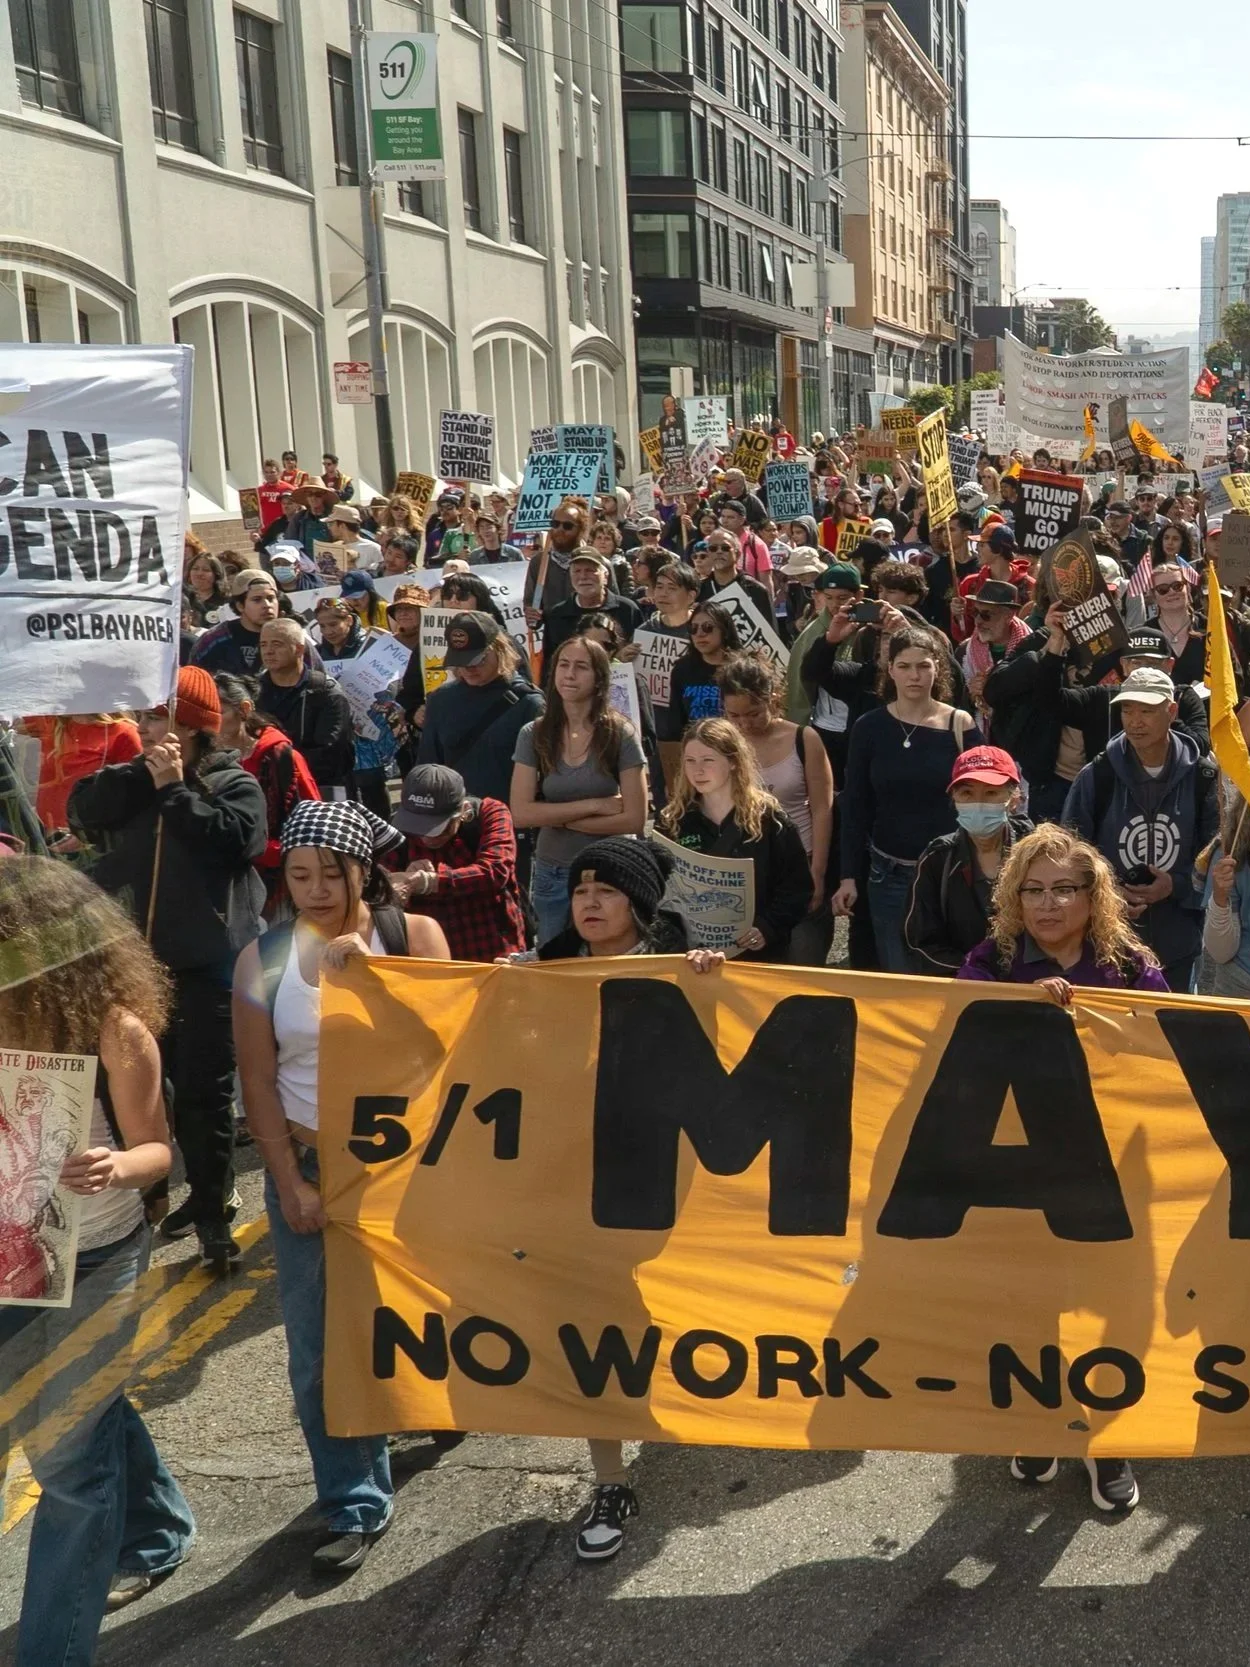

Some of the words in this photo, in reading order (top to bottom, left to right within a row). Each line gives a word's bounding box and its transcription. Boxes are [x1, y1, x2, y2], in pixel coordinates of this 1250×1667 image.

[379, 62, 405, 78] 511
[386, 116, 398, 124] 511
[386, 127, 409, 135] Getting
[388, 136, 410, 144] around
[412, 136, 423, 144] the
[393, 147, 405, 155] Bay
[414, 164, 436, 172] 511.org
[1034, 356, 1056, 366] MASS
[1032, 366, 1052, 375] STOP
[1053, 370, 1079, 378] RAIDS
[1081, 370, 1098, 378] AND
[1100, 370, 1164, 378] DEPORTATIONS!
[1046, 391, 1076, 400] SMASH
[1131, 392, 1167, 400] ATTACKS
[443, 412, 482, 422] MAY
[882, 416, 915, 430] NEEDS
[442, 421, 478, 434] STAND
[480, 426, 492, 437] UP
[532, 428, 553, 436] MAY
[442, 432, 454, 443] TO
[458, 434, 492, 448] TRUMP
[564, 437, 592, 448] STAND
[595, 437, 607, 448] UP
[641, 430, 658, 443] STOP
[738, 432, 768, 452] NO
[922, 418, 945, 469] STOP
[948, 436, 968, 446] MAY
[440, 444, 491, 464] GENERAL
[951, 454, 976, 466] TRUMP
[967, 448, 978, 458] UP
[530, 455, 572, 466] MONEY
[575, 455, 599, 466] FOR
[733, 455, 760, 472] WAR
[440, 460, 490, 481] STRIKE!
[531, 467, 592, 478] PEOPLE'S
[768, 464, 807, 477] WORKERS
[538, 479, 580, 490] NEEDS
[768, 478, 808, 496] POWER
[520, 494, 553, 510] NOT
[769, 495, 778, 506] TO
[780, 492, 810, 504] DEFEAT
[1021, 484, 1079, 506] TRUMP
[772, 502, 808, 516] TRUMP!
[1025, 501, 1072, 522] MUST
[518, 512, 542, 522] WAR
[1034, 518, 1059, 536] GO
[1076, 592, 1112, 624] FUERA
[26, 612, 173, 643] @PSLBAYAREA
[424, 616, 434, 628] NO
[1079, 612, 1114, 643] BAHÍA
[423, 636, 432, 647] NO
[1128, 638, 1160, 648] QUEST
[642, 653, 678, 672] TEAM
[408, 794, 434, 805] ABM
[693, 865, 717, 876] OFF
[720, 871, 746, 879] THE
[689, 874, 746, 888] MACHINE
[26, 1054, 85, 1072] DISASTER
[346, 1082, 523, 1167] 5/1
[372, 1305, 531, 1387] NO
[558, 1322, 893, 1400] WORK
[988, 1342, 1146, 1413] NO
